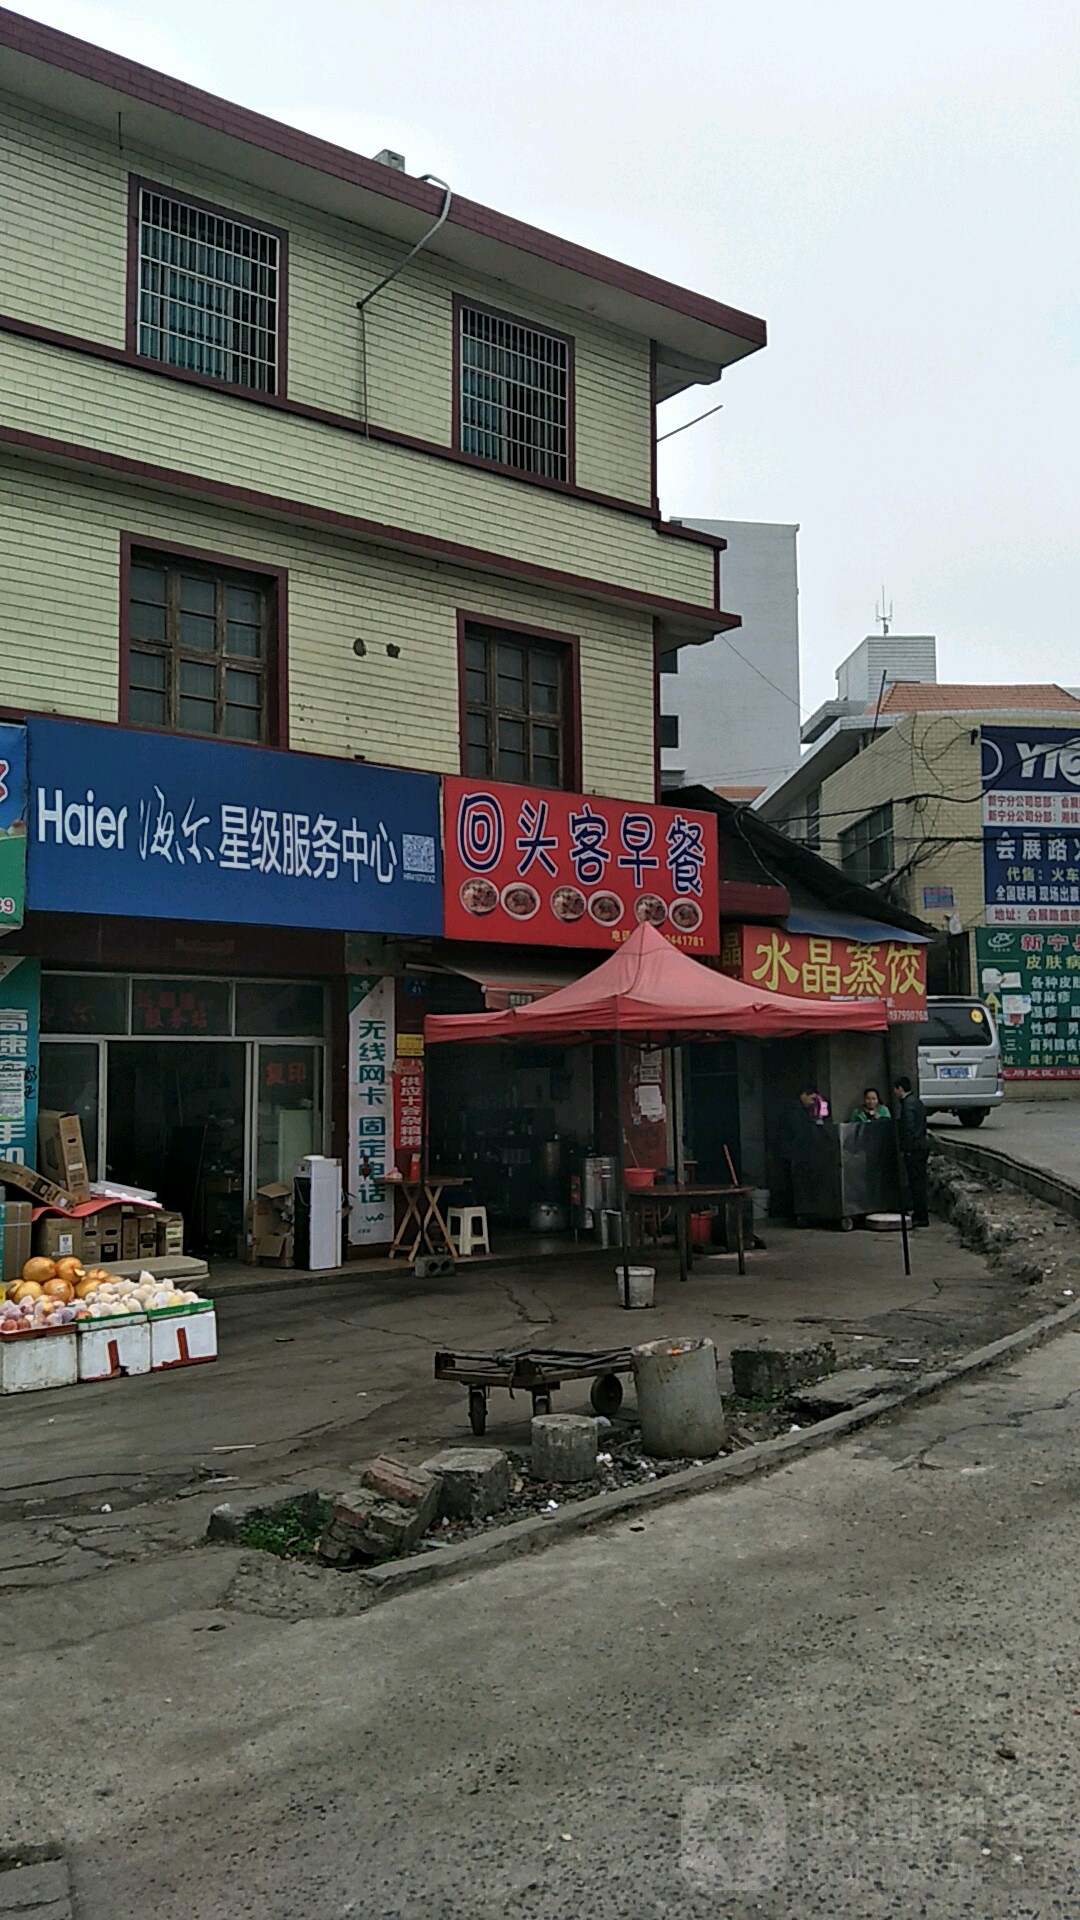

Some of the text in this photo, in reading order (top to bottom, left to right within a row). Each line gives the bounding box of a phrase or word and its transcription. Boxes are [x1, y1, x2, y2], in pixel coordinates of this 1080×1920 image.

[37, 786, 128, 850] Haier
[456, 790, 706, 898] 回头客早餐
[751, 932, 925, 997] 水晶蒸饺
[358, 1020, 387, 1106] 无线网卡
[358, 1115, 387, 1204] 固定电话
